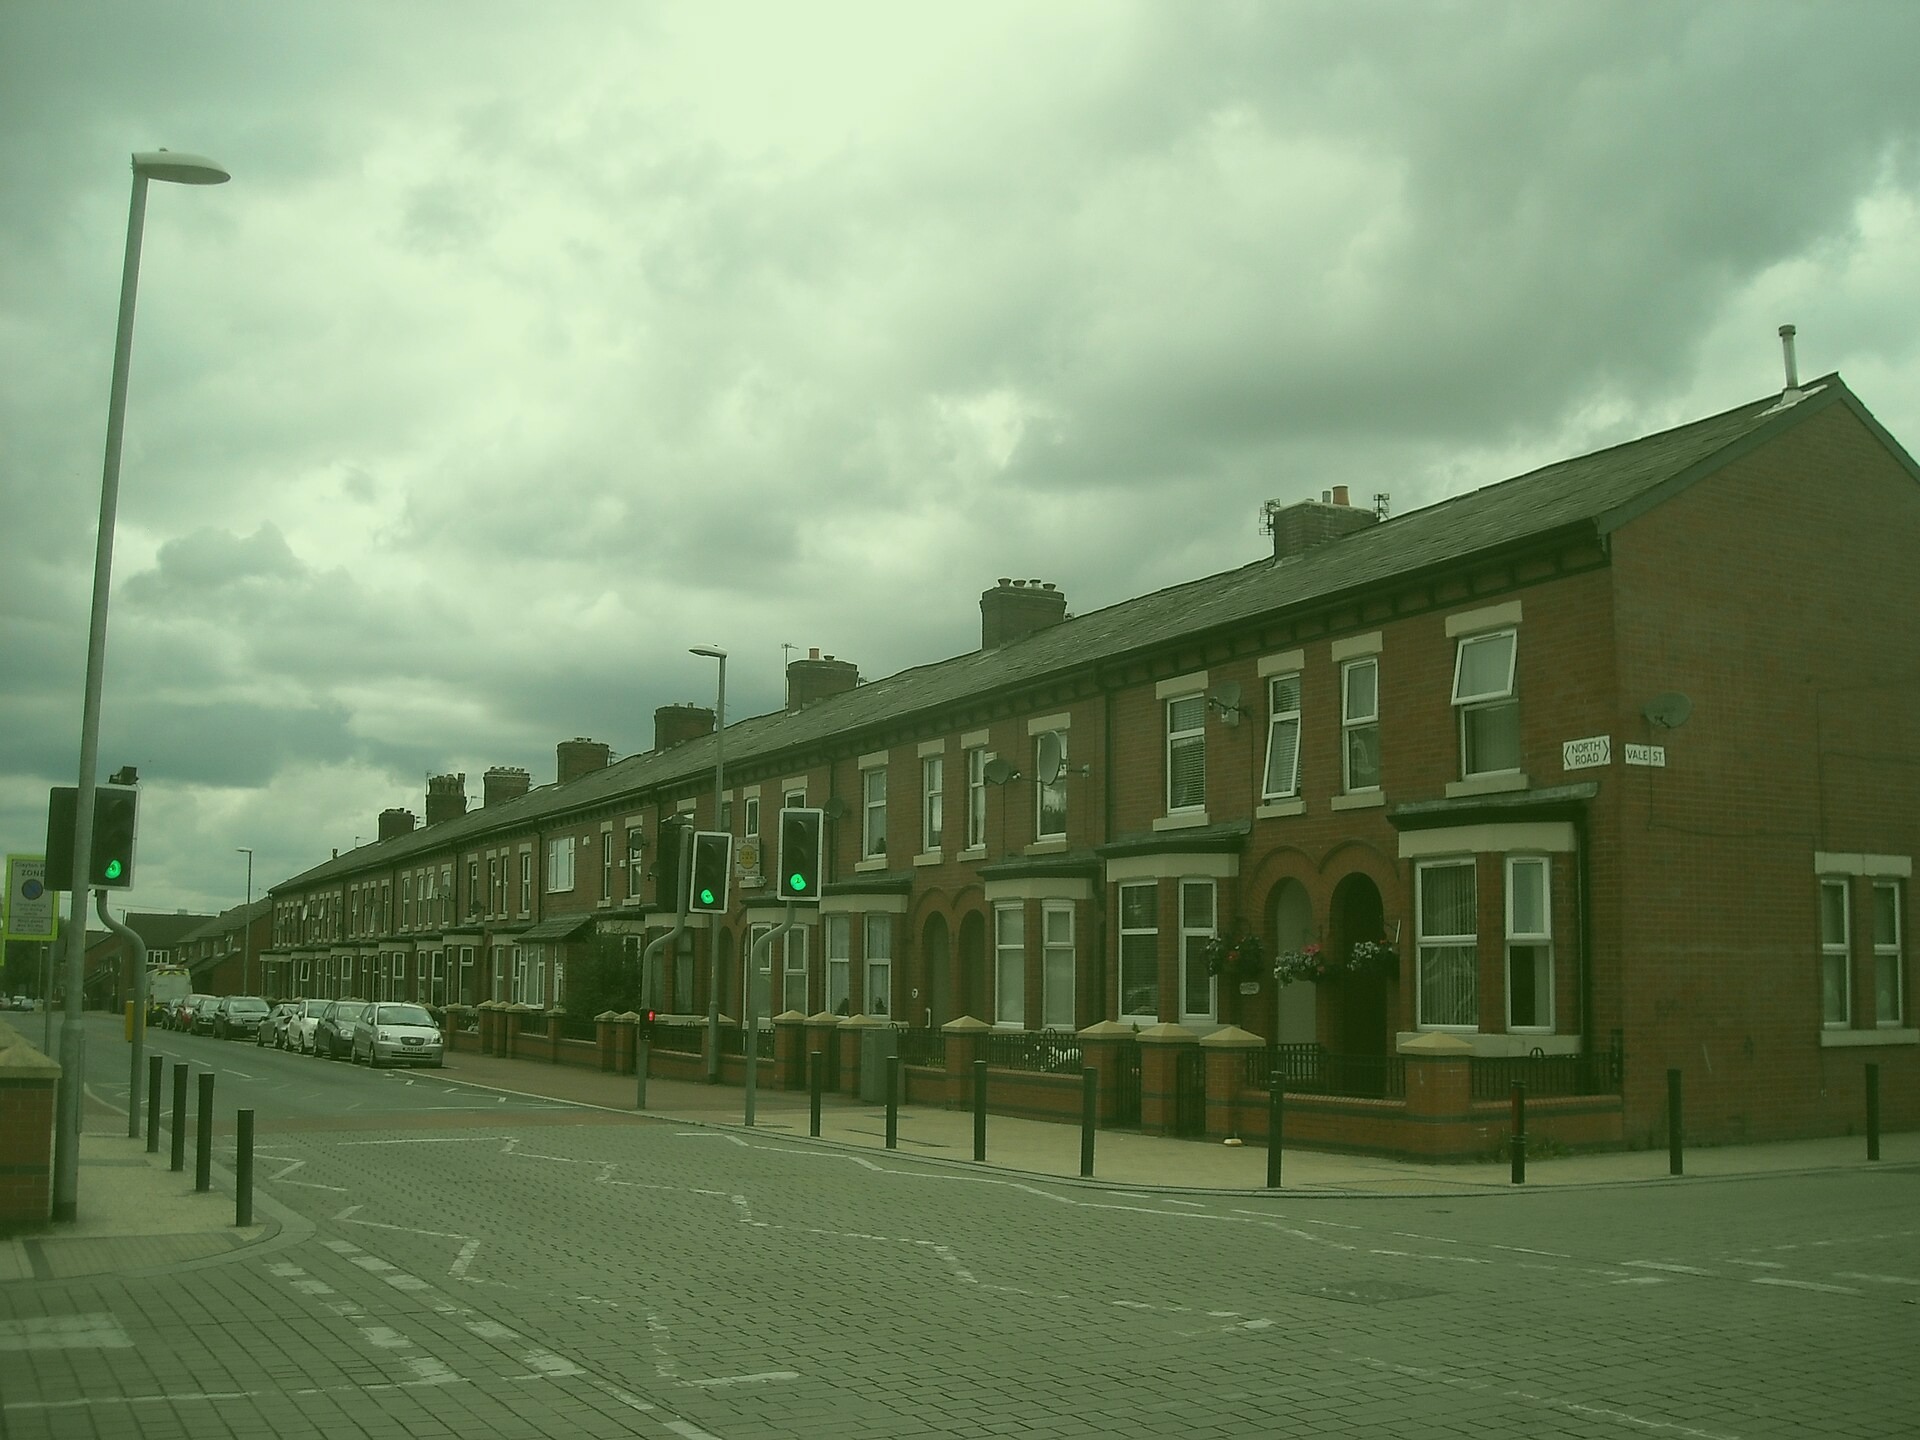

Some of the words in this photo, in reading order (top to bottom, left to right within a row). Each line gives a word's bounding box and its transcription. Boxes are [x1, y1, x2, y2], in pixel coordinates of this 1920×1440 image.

[1571, 741, 1601, 754] NORTH
[1576, 753, 1599, 765] ROAD
[1627, 750, 1648, 760] VALE
